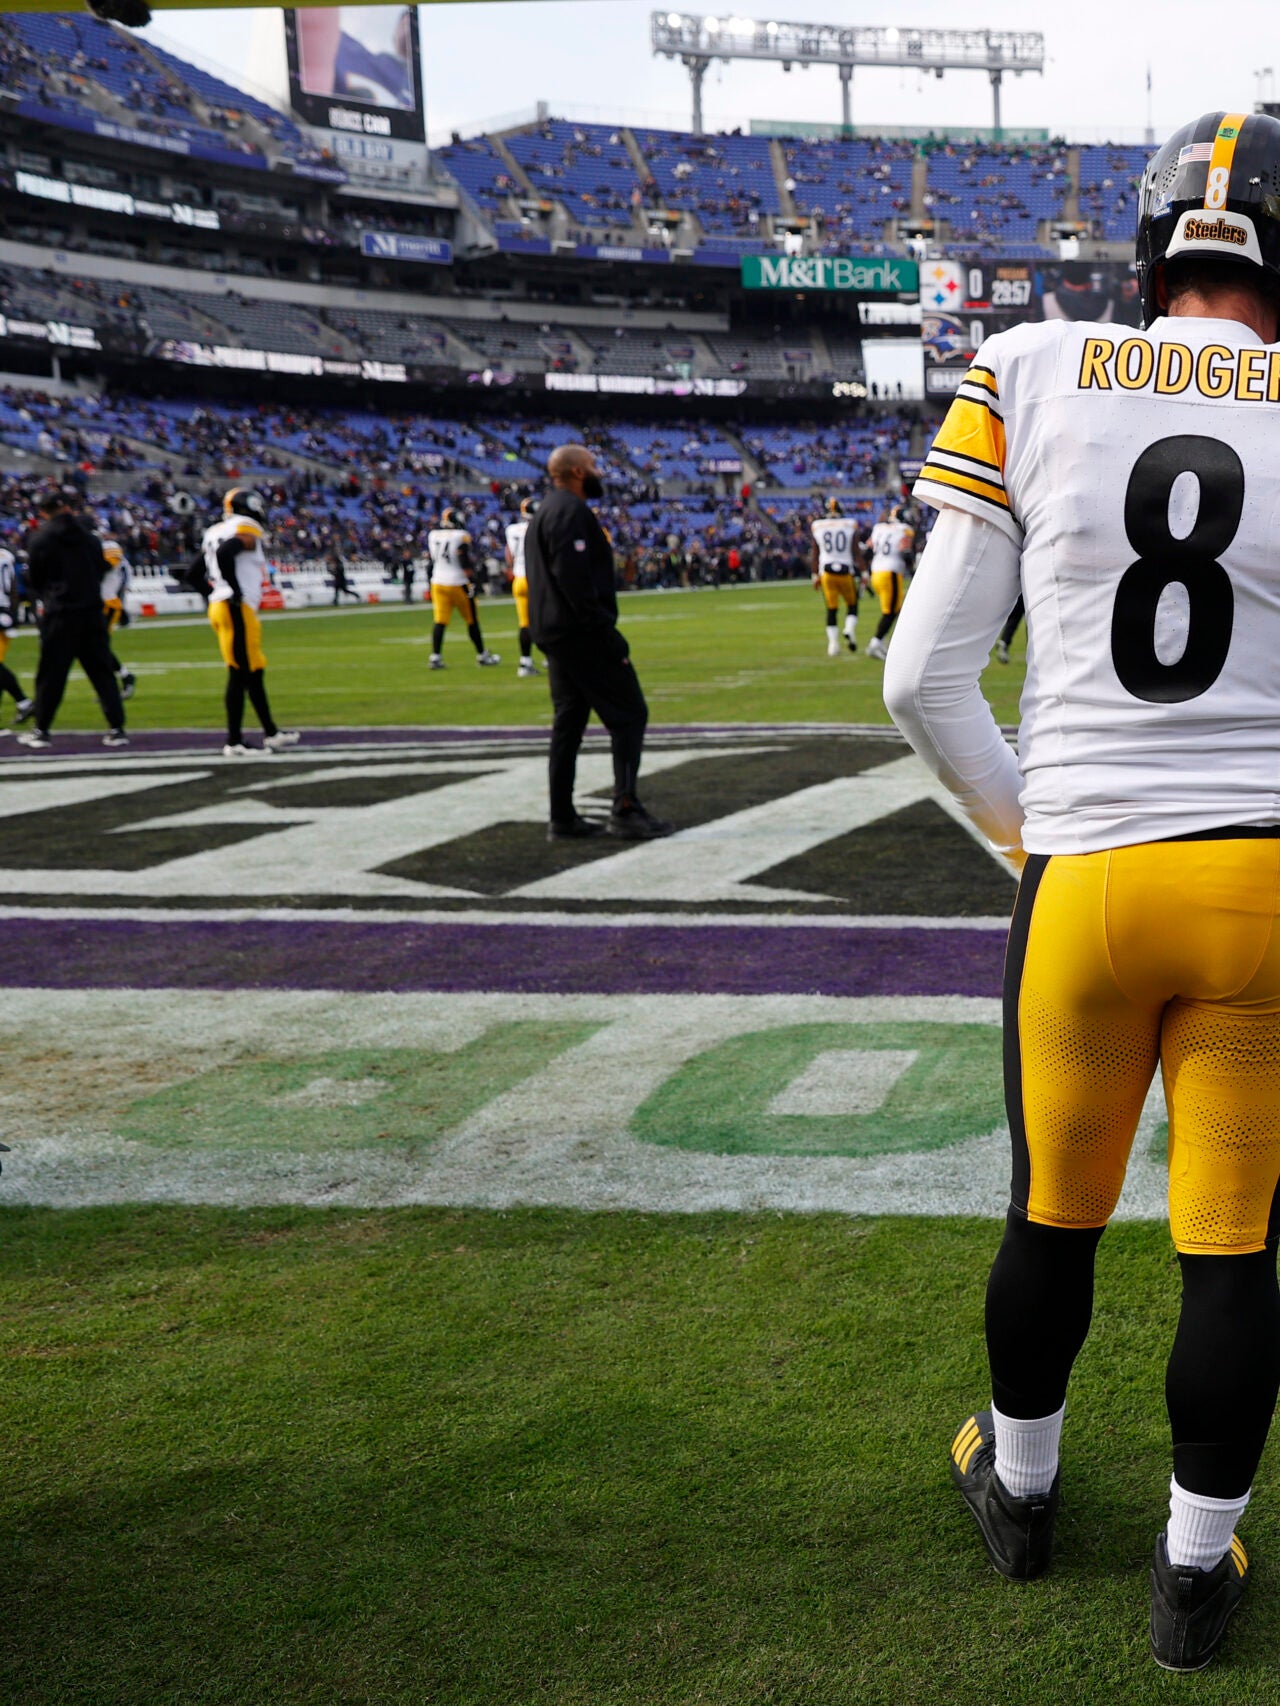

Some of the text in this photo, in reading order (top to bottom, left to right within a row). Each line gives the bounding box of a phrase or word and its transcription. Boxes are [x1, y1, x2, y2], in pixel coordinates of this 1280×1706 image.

[1205, 166, 1229, 209] 8
[1184, 218, 1247, 245] Steelers
[759, 257, 902, 289] M&T Bank
[969, 268, 983, 298] 0
[970, 319, 984, 349] 0
[823, 530, 847, 553] 80
[1110, 434, 1245, 704] 8
